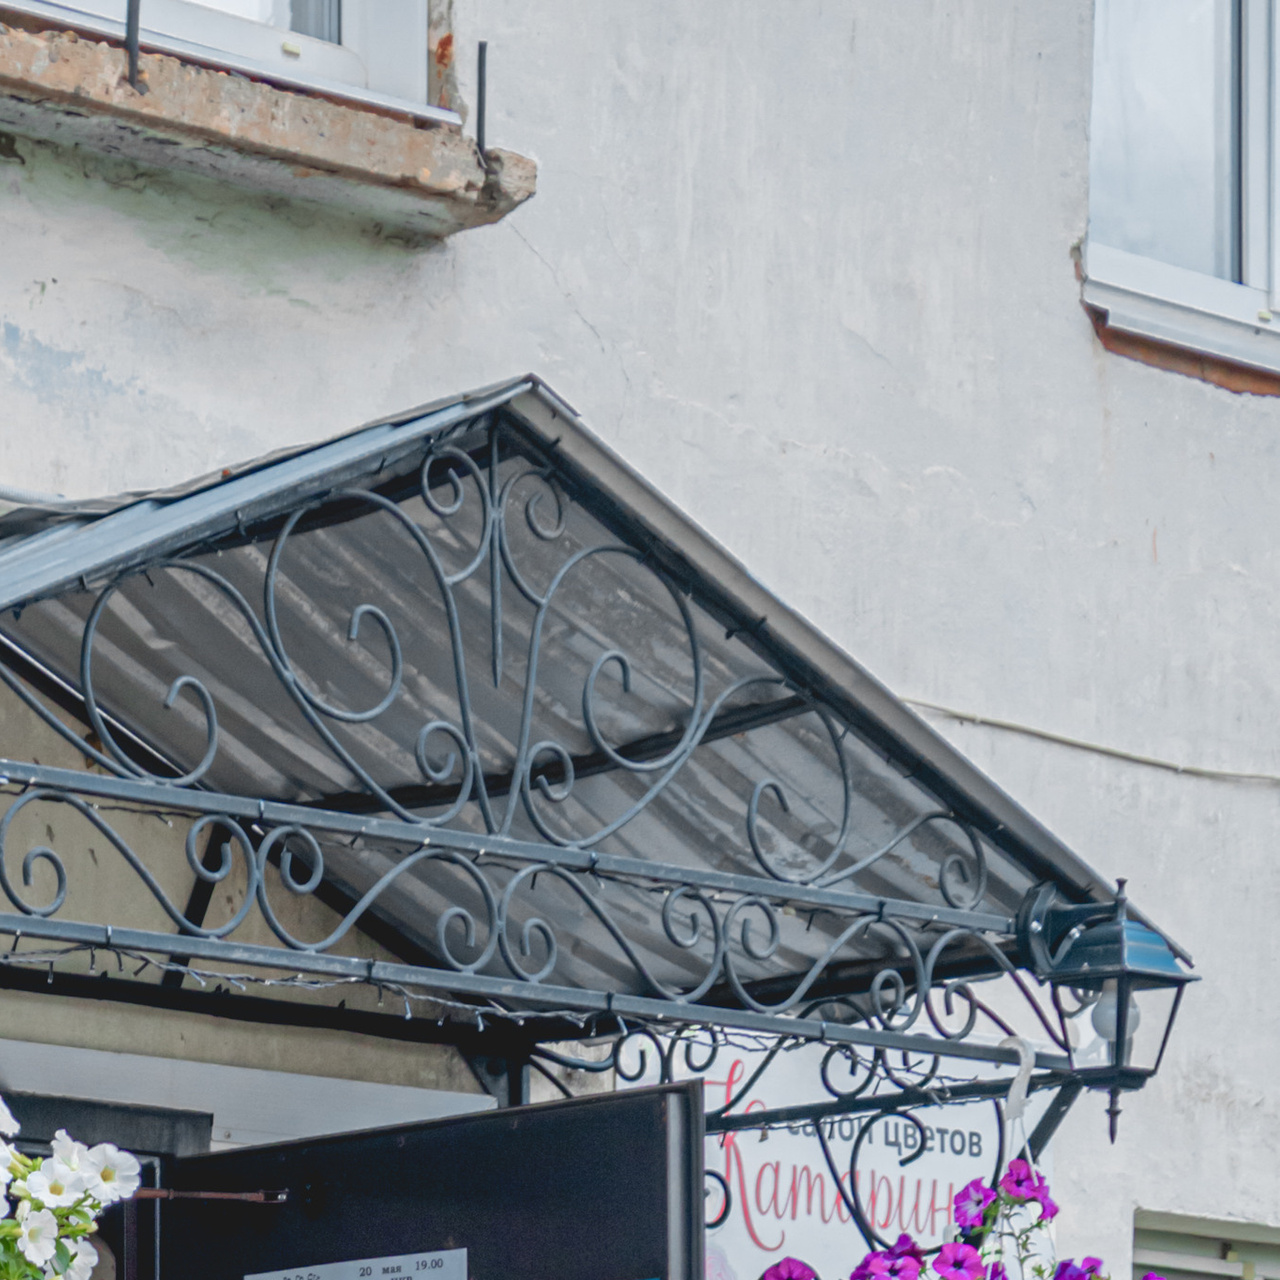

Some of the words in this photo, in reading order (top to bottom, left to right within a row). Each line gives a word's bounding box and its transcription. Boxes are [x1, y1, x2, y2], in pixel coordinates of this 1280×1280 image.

[884, 1119, 983, 1158] цветов
[359, 1266, 373, 1277] 20
[382, 1265, 402, 1275] мая
[415, 1258, 444, 1271] 19.00
